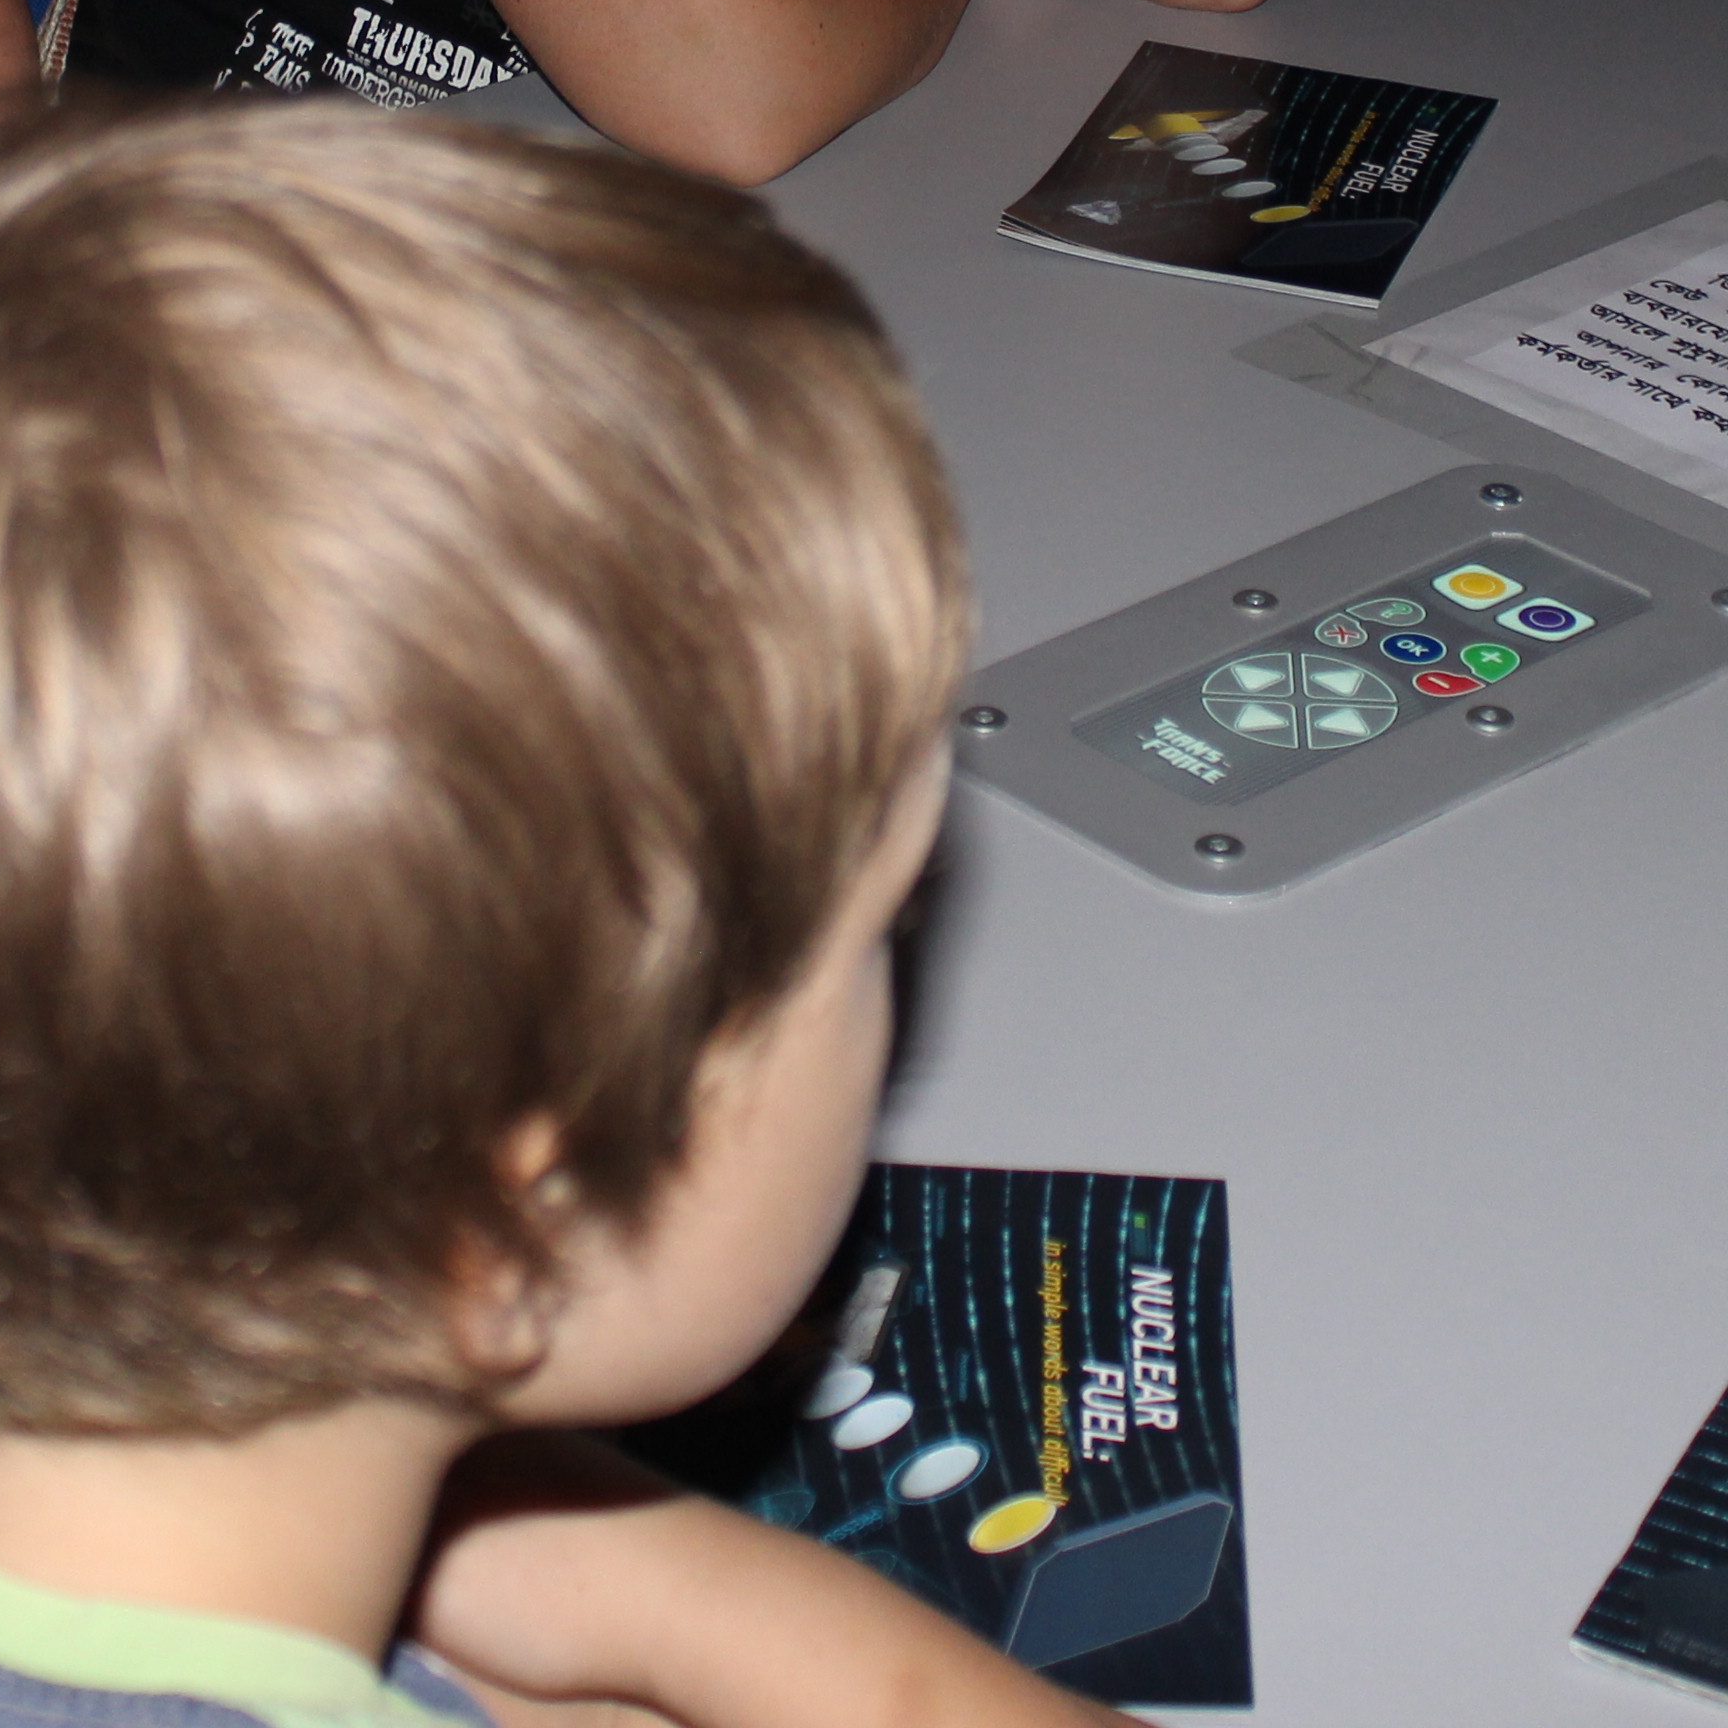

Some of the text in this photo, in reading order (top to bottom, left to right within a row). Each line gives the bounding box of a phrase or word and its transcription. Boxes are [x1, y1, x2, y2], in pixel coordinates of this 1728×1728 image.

[253, 44, 311, 95] FANS
[1380, 128, 1439, 193] NUCLEAR
[1649, 279, 1710, 302] কেউ
[1590, 303, 1671, 341] আসলে
[1576, 330, 1670, 372] আপনার
[1628, 377, 1692, 409] সাথে
[1396, 639, 1430, 658] OK
[1043, 1240, 1067, 1258] in
[1037, 1261, 1068, 1321] simple
[1043, 1324, 1069, 1381] words
[1130, 1266, 1178, 1432] NUCLEAR
[1043, 1384, 1069, 1437] about
[1080, 1362, 1127, 1462] FUEL:
